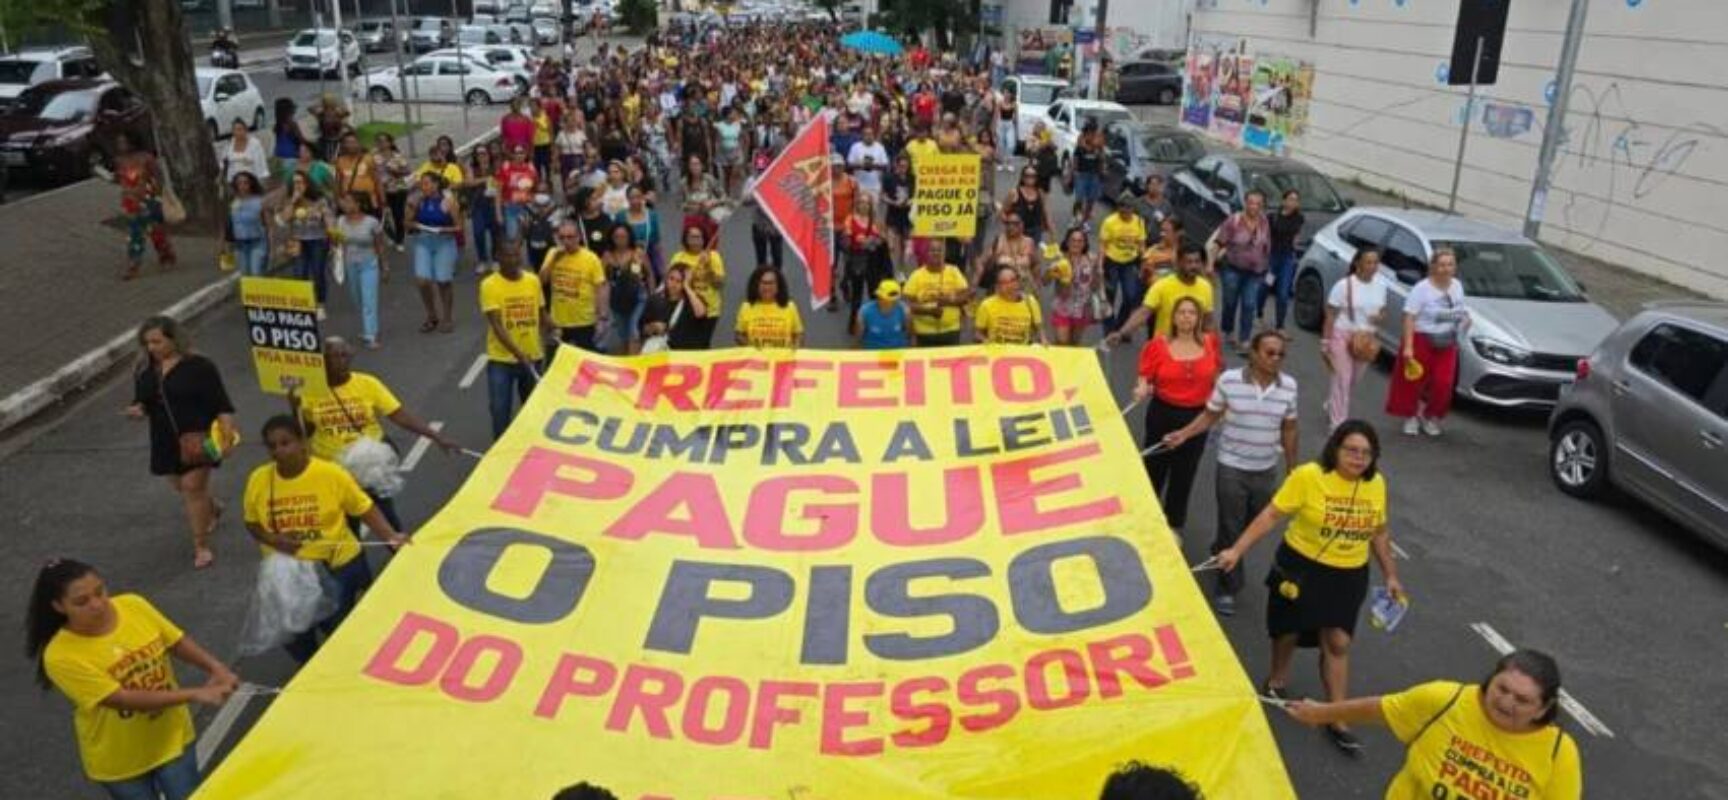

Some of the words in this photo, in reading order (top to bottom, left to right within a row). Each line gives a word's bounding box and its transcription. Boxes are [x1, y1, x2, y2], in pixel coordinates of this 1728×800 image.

[917, 203, 952, 216] PISO
[918, 188, 961, 199] PAGUE
[965, 188, 976, 199] O
[247, 307, 275, 323] NÃO
[278, 311, 314, 327] PAGA
[251, 326, 266, 345] O
[271, 328, 318, 350] PISO
[567, 357, 1077, 411] PREFEITO,
[543, 408, 862, 465] CUMPRA
[882, 420, 933, 462] A
[953, 405, 1094, 458] LEI!
[490, 442, 1123, 551] PAGUE
[436, 526, 597, 625] O
[642, 535, 1154, 666] PISO
[363, 612, 524, 702] DO
[534, 625, 1194, 757] PROFESSOR!
